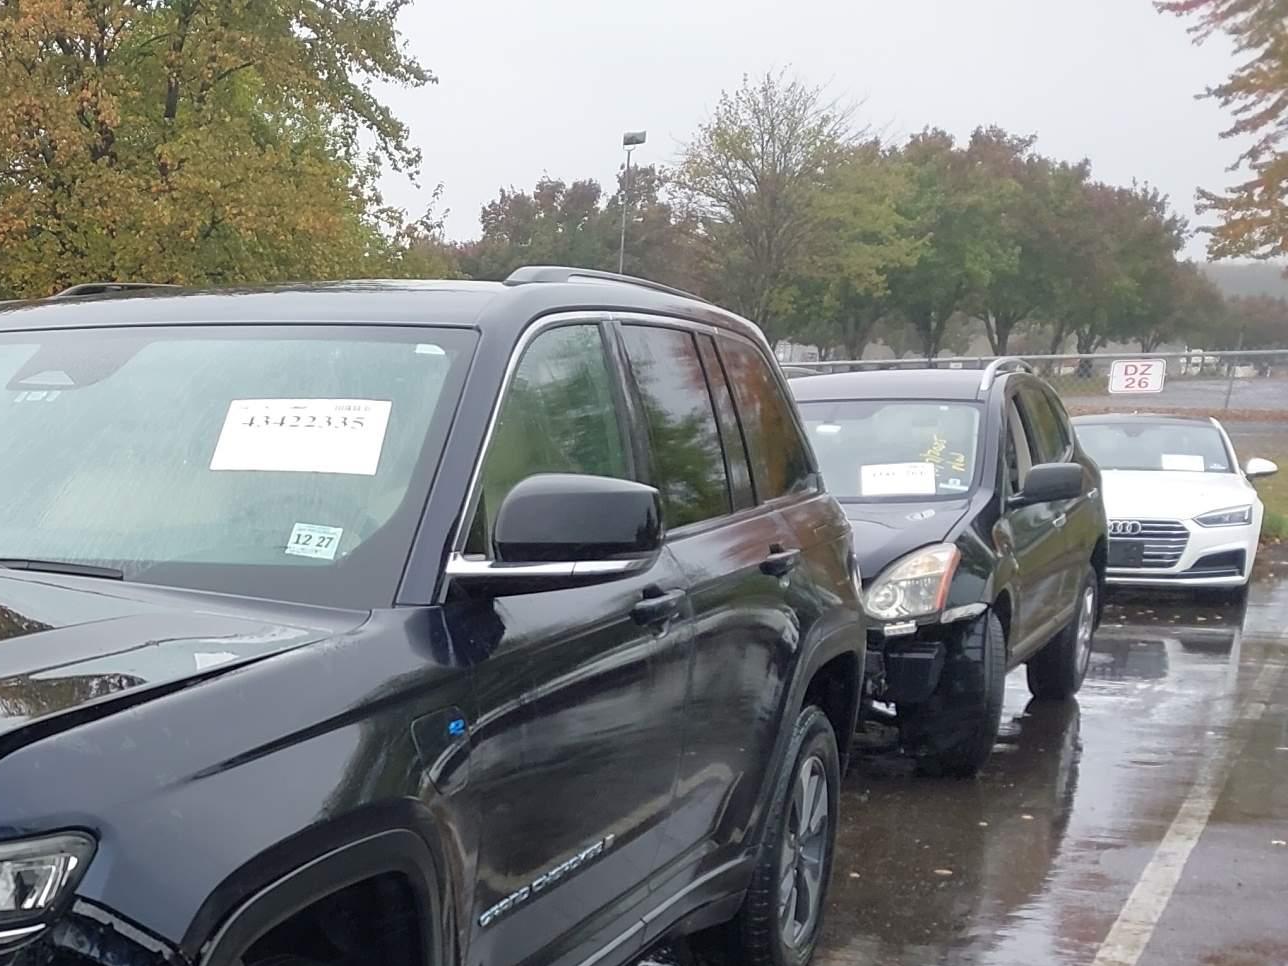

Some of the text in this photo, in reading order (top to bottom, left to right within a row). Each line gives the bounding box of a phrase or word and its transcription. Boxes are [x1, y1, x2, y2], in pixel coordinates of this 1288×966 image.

[1124, 364, 1153, 376] DZ
[1125, 377, 1149, 389] 26
[241, 415, 365, 430] 43422335
[294, 533, 334, 549] 12 27
